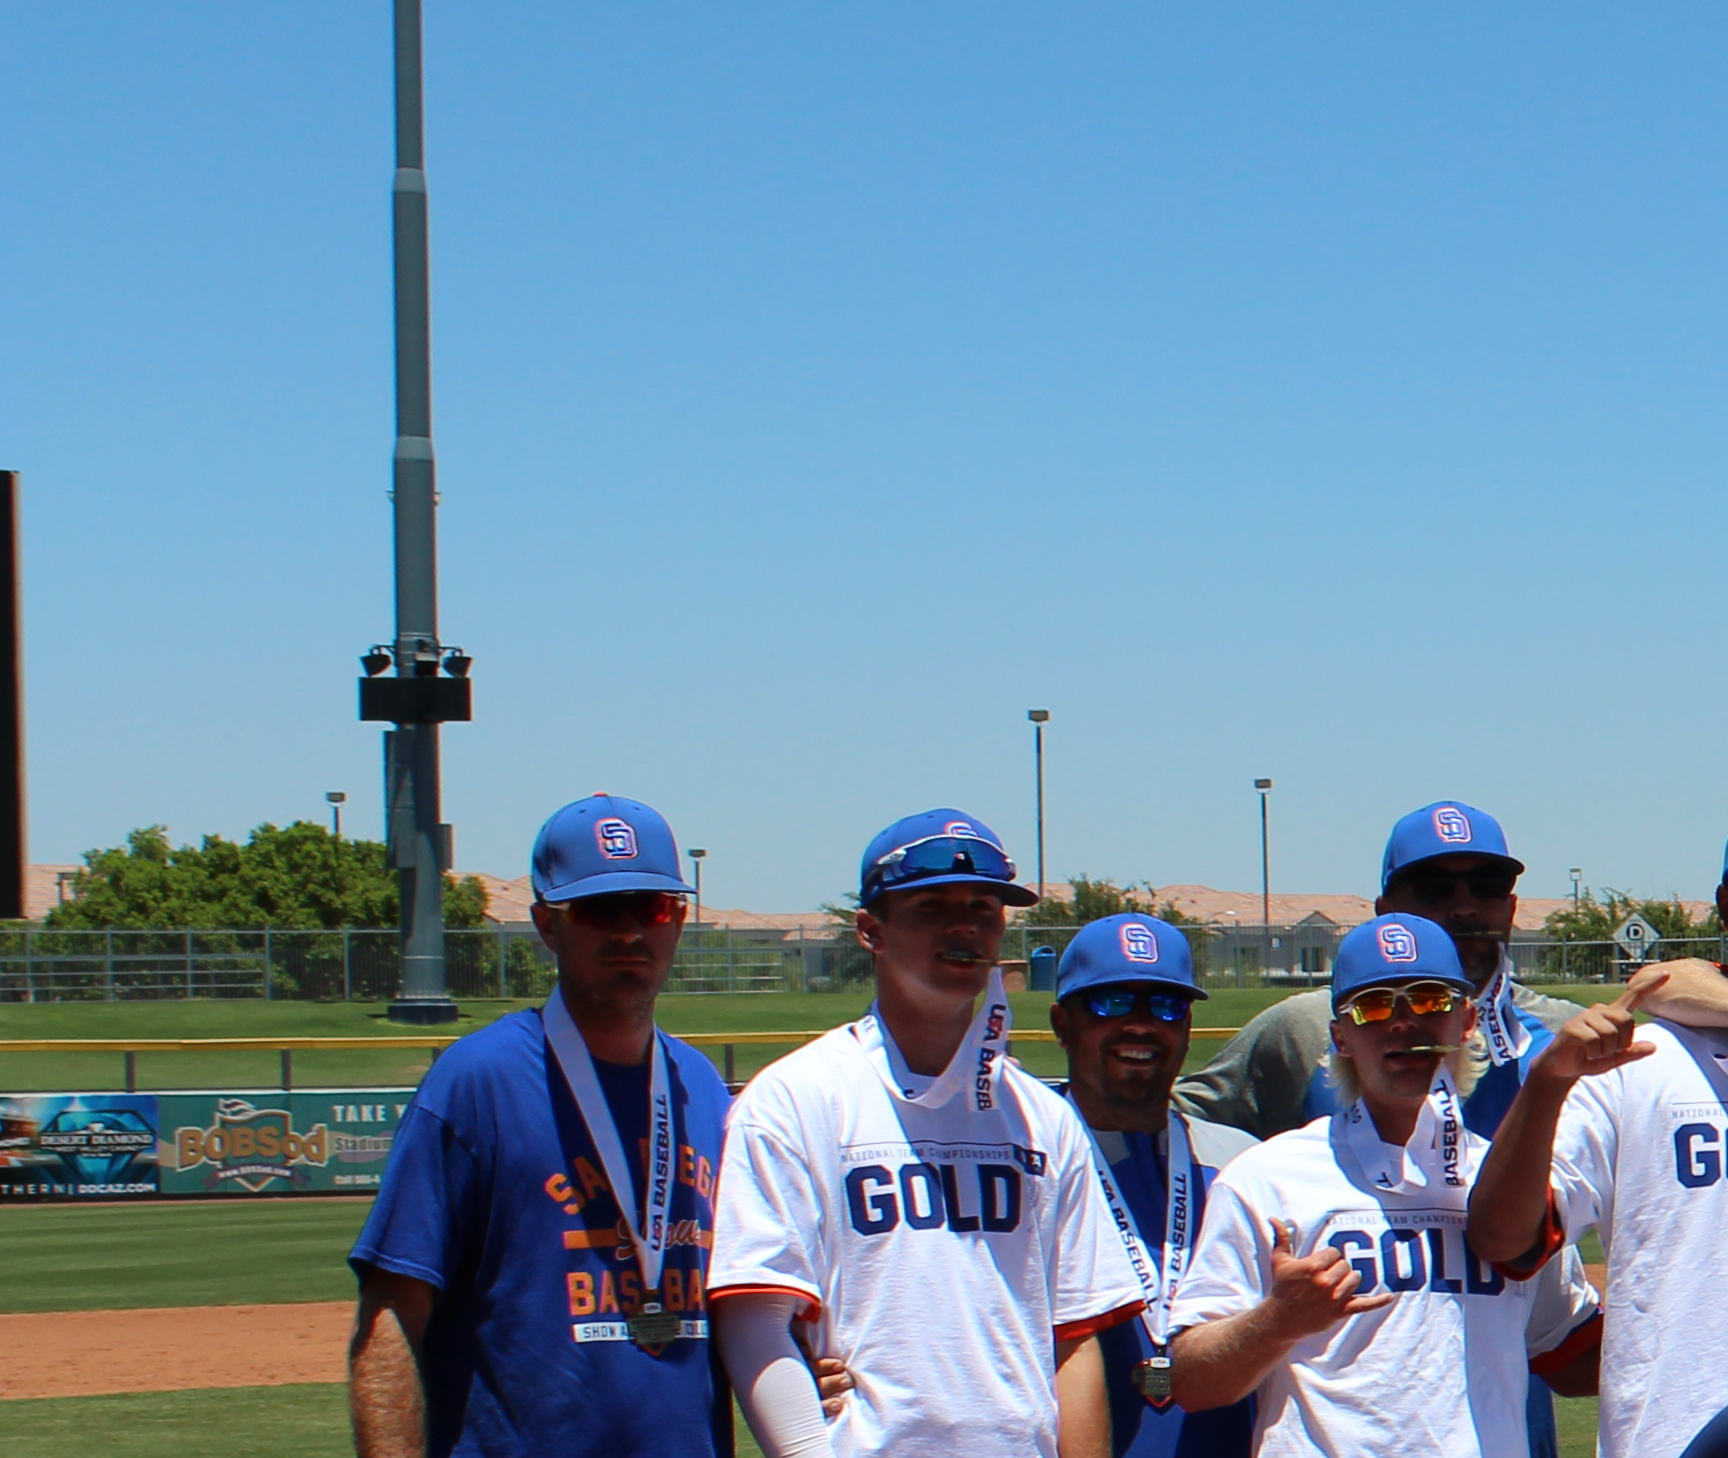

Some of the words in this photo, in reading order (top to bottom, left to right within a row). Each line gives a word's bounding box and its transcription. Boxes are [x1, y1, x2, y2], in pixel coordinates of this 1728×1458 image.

[1630, 926, 1643, 939] D
[984, 1003, 1007, 1041] USA
[333, 1105, 387, 1122] TAKE
[1672, 1108, 1724, 1119] NATIONAL
[41, 1135, 88, 1145] DESERT
[92, 1133, 153, 1144] DIAMOND
[653, 1094, 668, 1209] BASEBALL
[842, 1150, 897, 1163] NATIONAL
[845, 1162, 1022, 1236] GOLD
[1171, 1172, 1188, 1273] BASEBALL
[1110, 1206, 1158, 1314] BASEBALL
[1328, 1227, 1506, 1297] GOLD
[566, 1268, 707, 1317] BASBA
